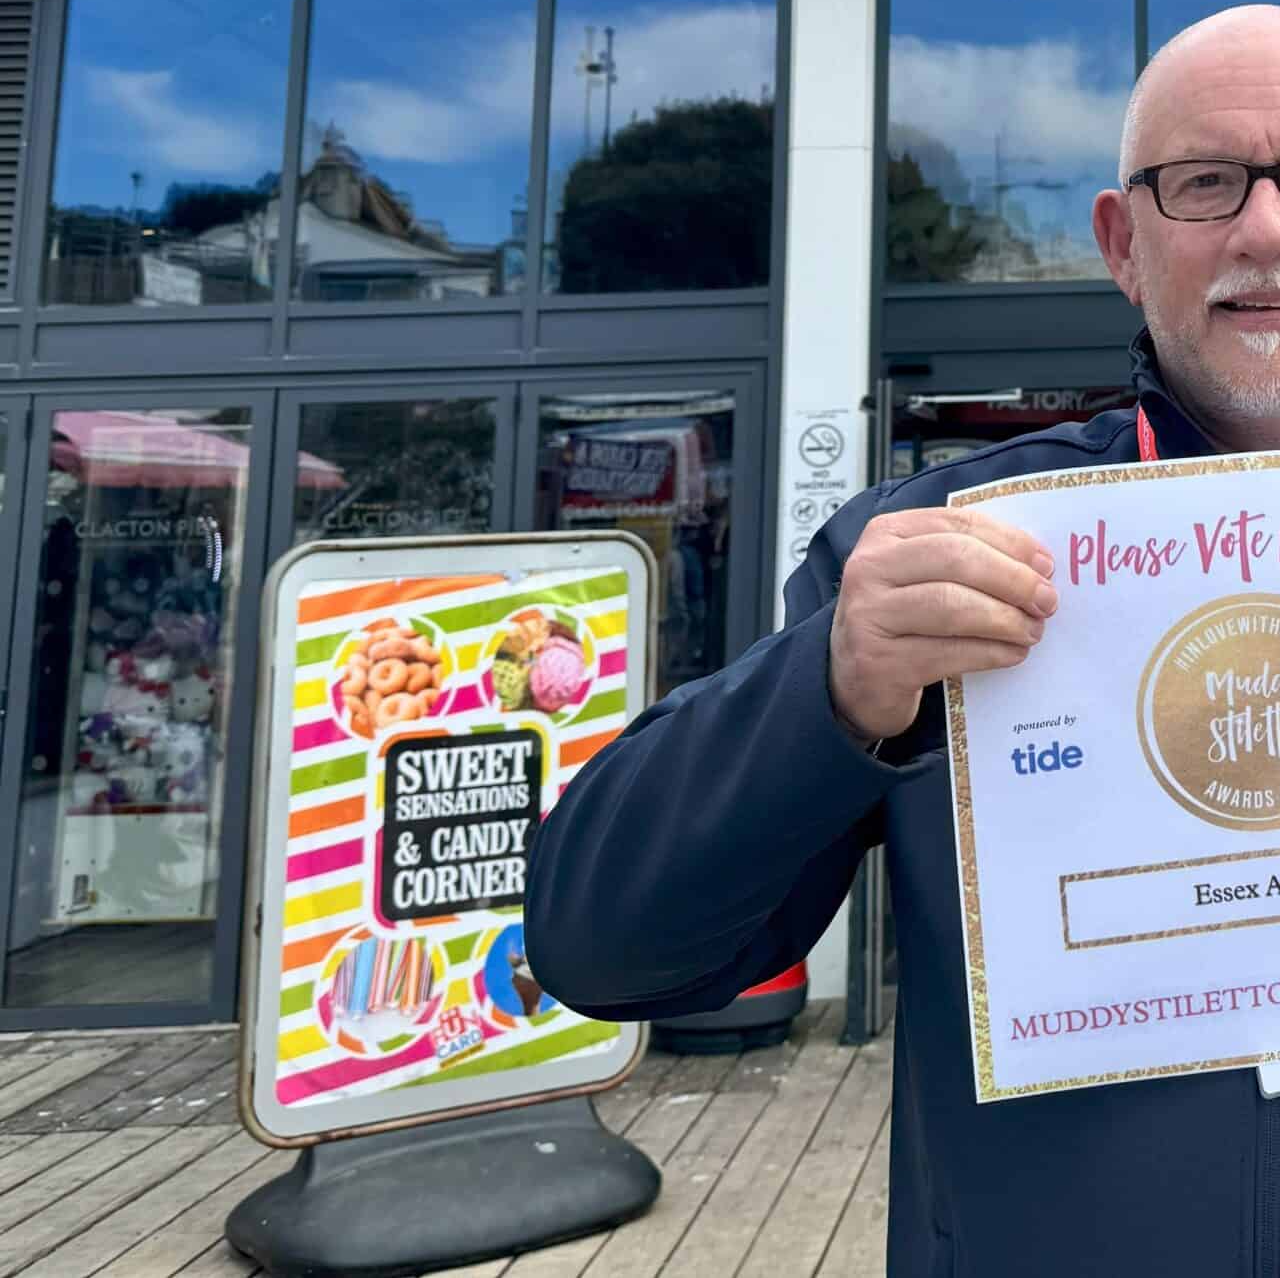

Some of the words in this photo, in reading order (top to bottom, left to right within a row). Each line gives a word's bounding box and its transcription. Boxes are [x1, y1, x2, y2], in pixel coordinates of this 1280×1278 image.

[75, 520, 170, 538] CLACTON
[1070, 519, 1187, 585] Please
[1194, 510, 1273, 582] Vote
[1013, 715, 1061, 734] sponsored
[1064, 714, 1077, 727] by
[397, 740, 534, 795] SWEET
[1011, 740, 1083, 775] tide
[396, 783, 530, 821] SENSATIONS
[1204, 780, 1275, 809] AWARDS
[394, 831, 422, 866] &
[430, 818, 531, 862] CANDY
[393, 856, 526, 909] CORNER
[1193, 883, 1262, 906] Essex
